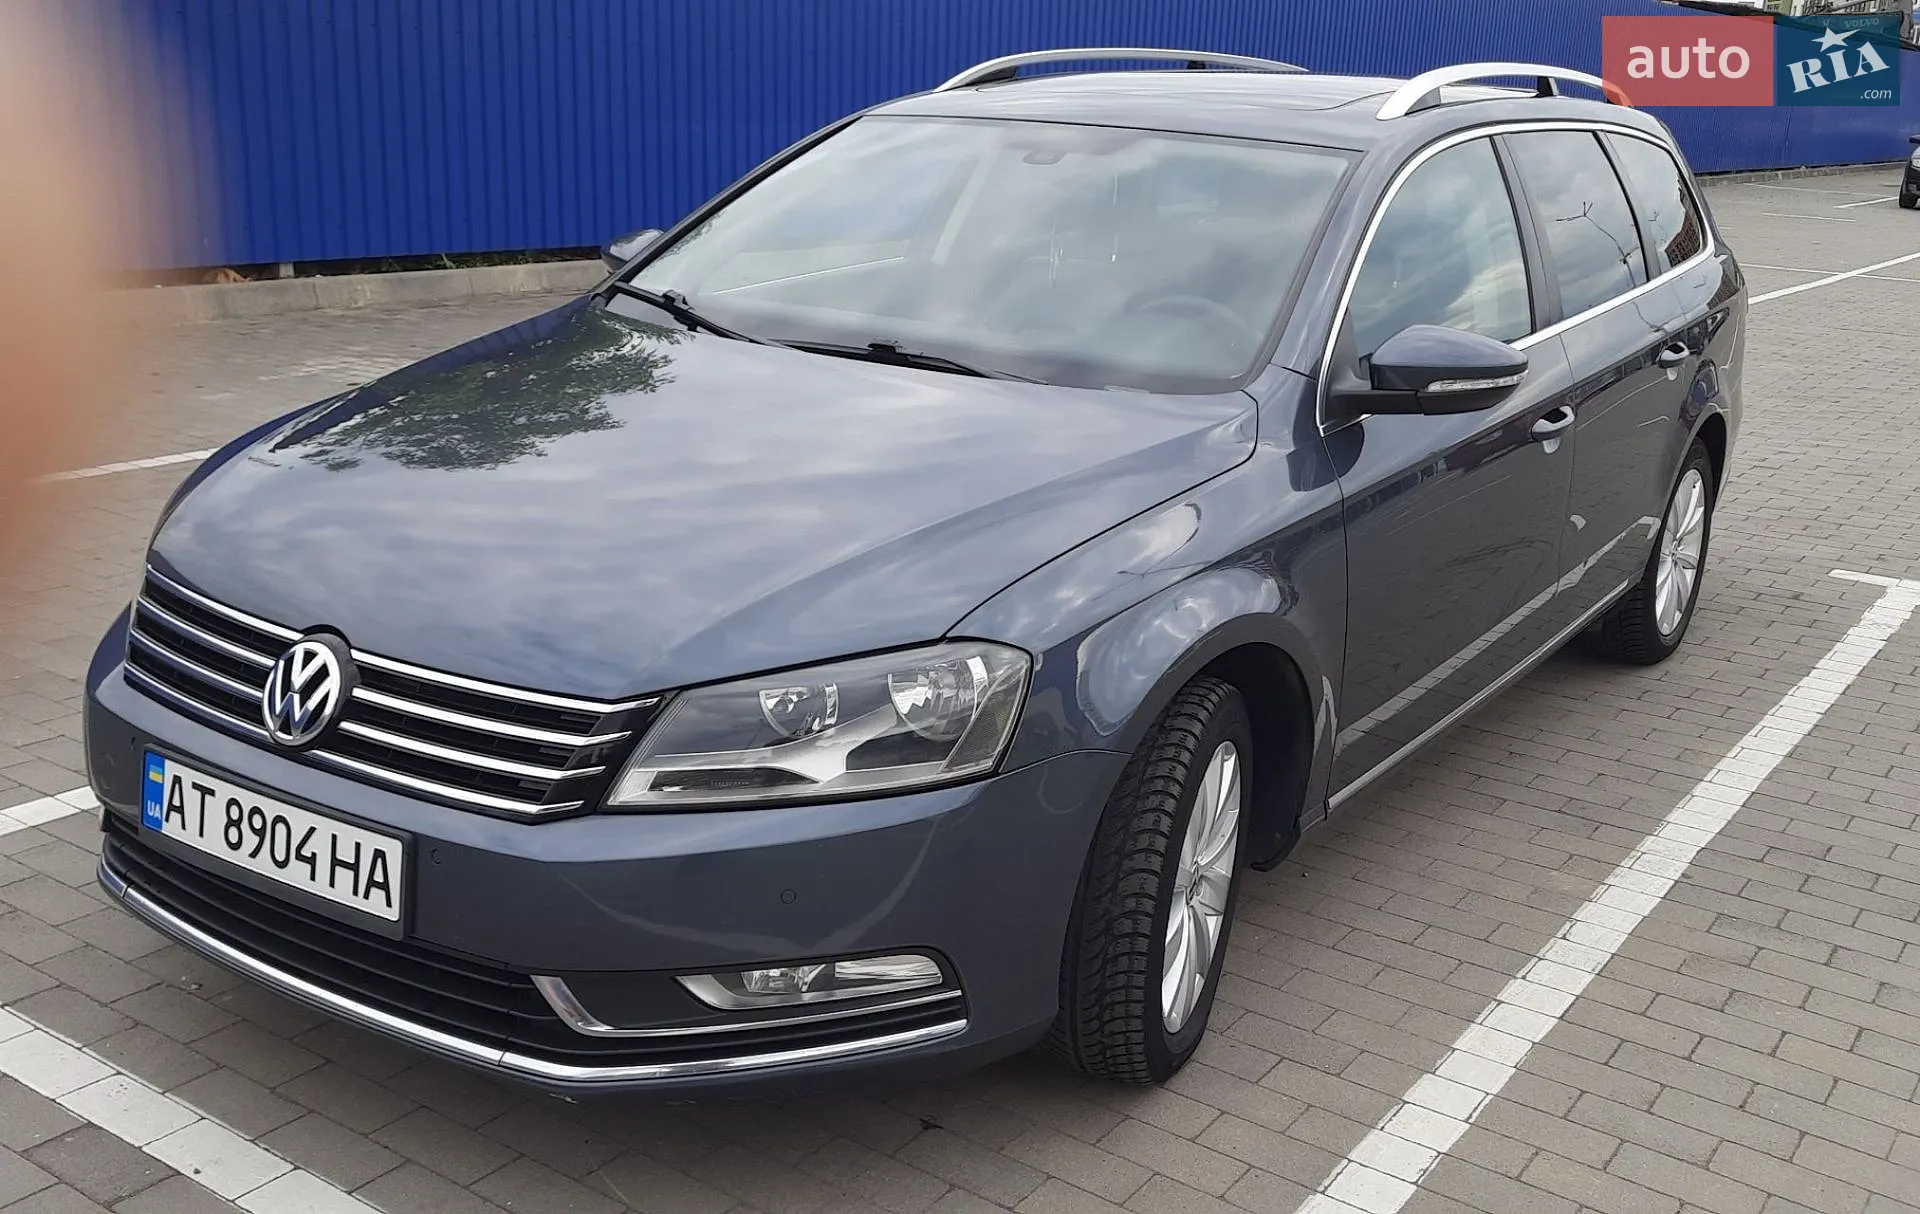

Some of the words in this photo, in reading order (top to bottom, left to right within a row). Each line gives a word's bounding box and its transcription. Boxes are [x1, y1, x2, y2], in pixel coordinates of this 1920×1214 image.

[1844, 18, 1880, 28] VOLVO
[147, 800, 161, 819] UA
[165, 774, 216, 838] AT
[223, 797, 317, 882] 8904
[329, 833, 393, 909] HA
